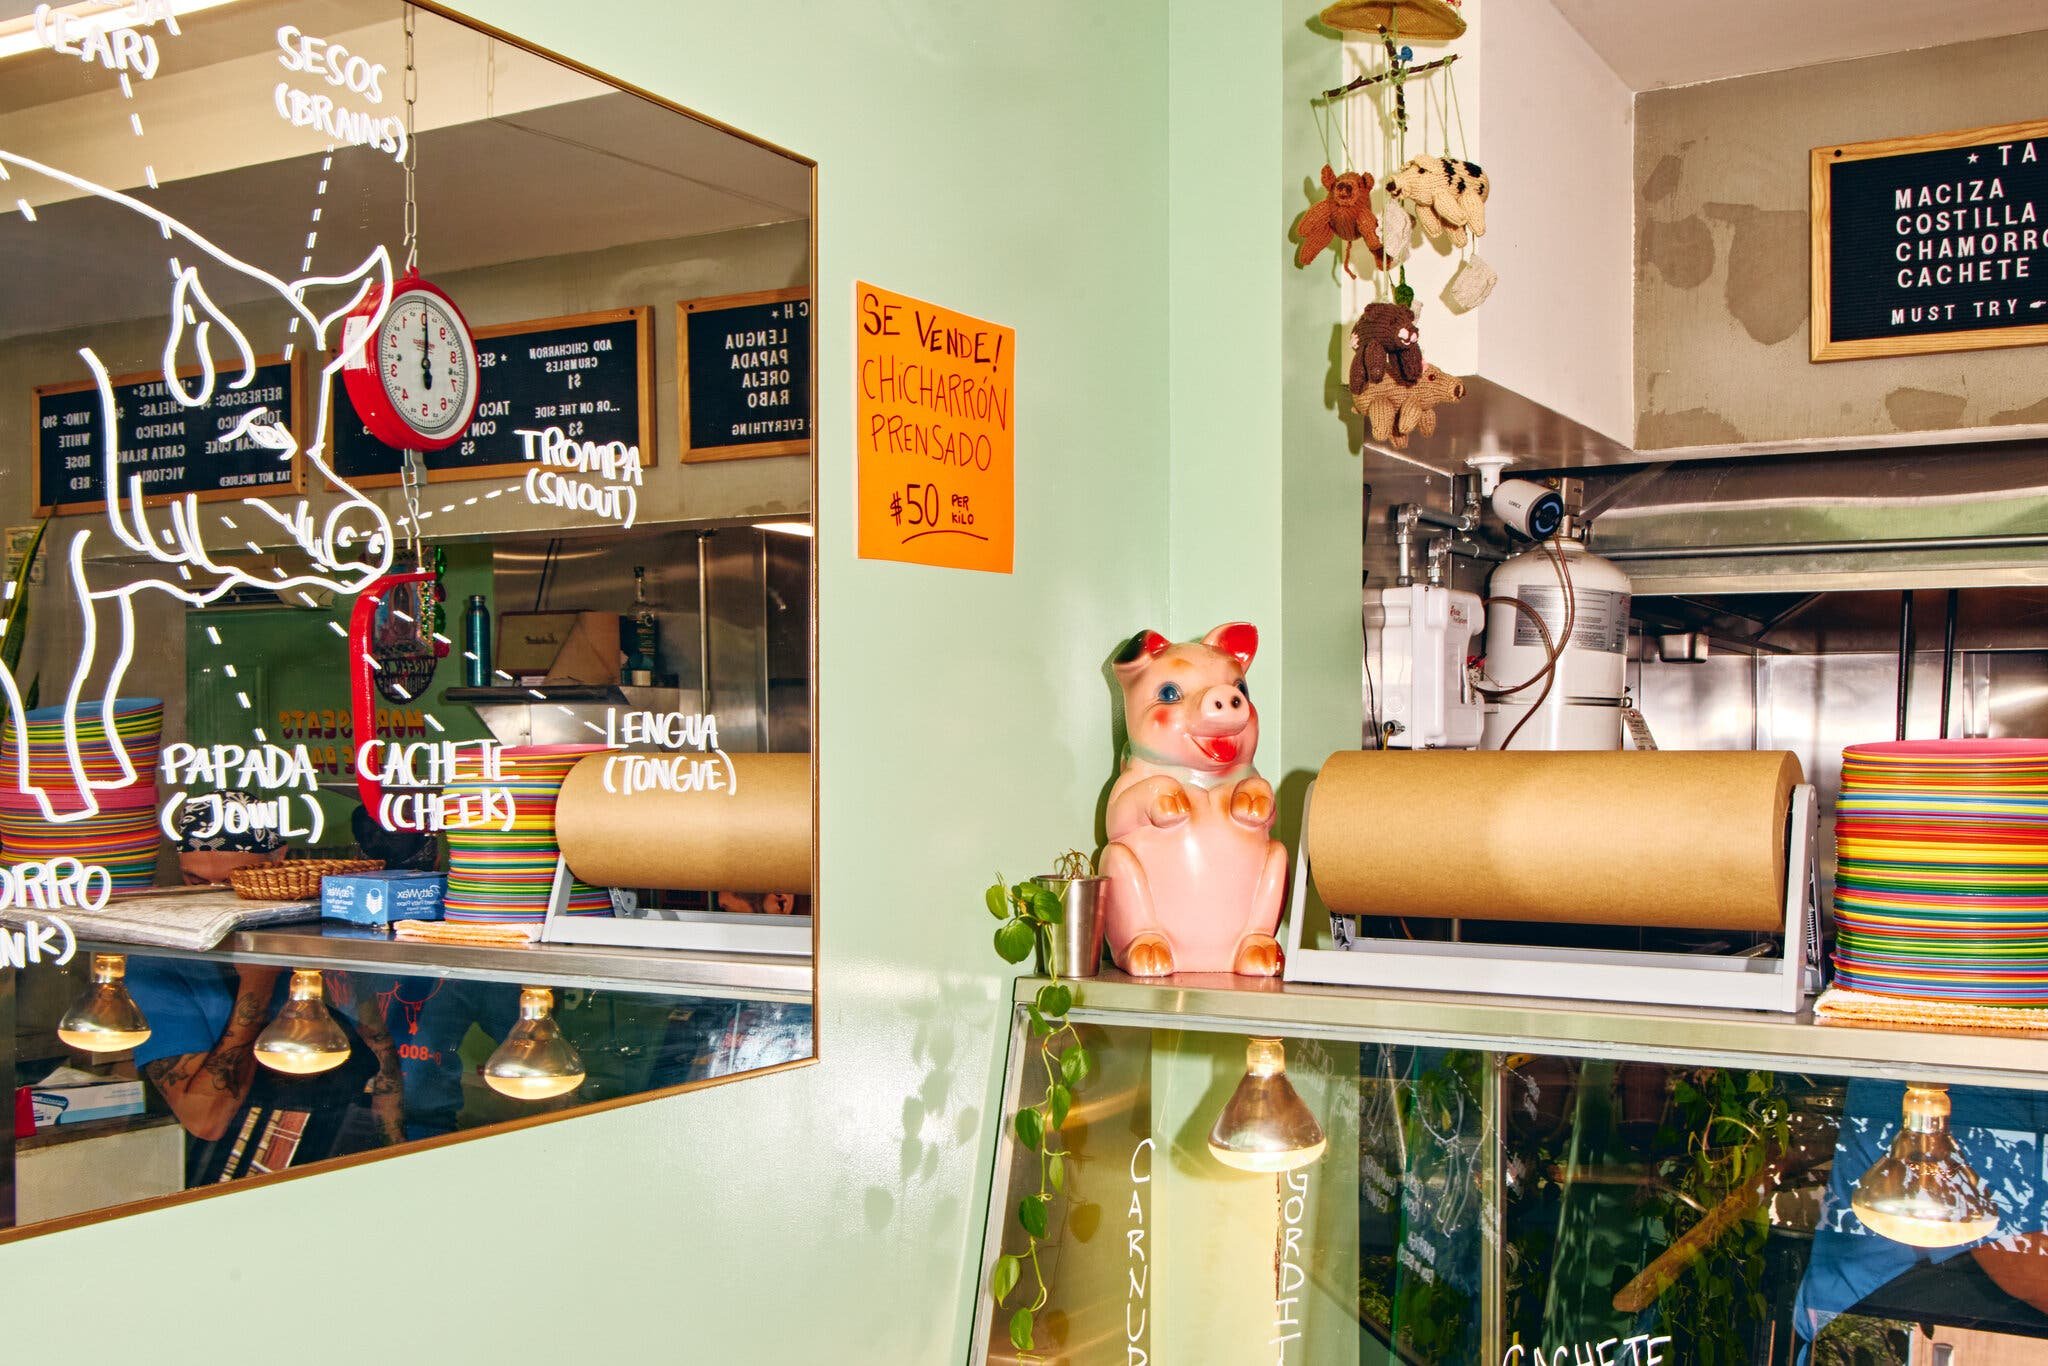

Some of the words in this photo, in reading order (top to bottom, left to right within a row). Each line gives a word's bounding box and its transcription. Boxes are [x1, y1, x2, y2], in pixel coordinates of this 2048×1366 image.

[277, 25, 387, 103] SESOS
[275, 82, 408, 163] (BRAINS)
[1895, 178, 2004, 210] MACIZA
[1896, 202, 2036, 235] COSTILLA
[1898, 257, 2030, 288] CACHETE
[863, 293, 902, 336] SE
[915, 310, 1002, 373] VENDE!
[1891, 304, 1955, 325] MUST
[1974, 299, 2018, 317] TRY
[513, 426, 643, 486] TROMPA
[872, 414, 991, 471] PRENSADO
[525, 468, 637, 529] (SNOUT)
[890, 483, 939, 527] $50
[951, 494, 969, 510] PER
[607, 707, 719, 751] LENGUA
[160, 742, 319, 791] PAPADA
[356, 739, 521, 786] CACHETE
[603, 749, 737, 796] (TONGUE)
[160, 791, 324, 844] (JOWL)
[378, 787, 517, 832] (CHEEK)
